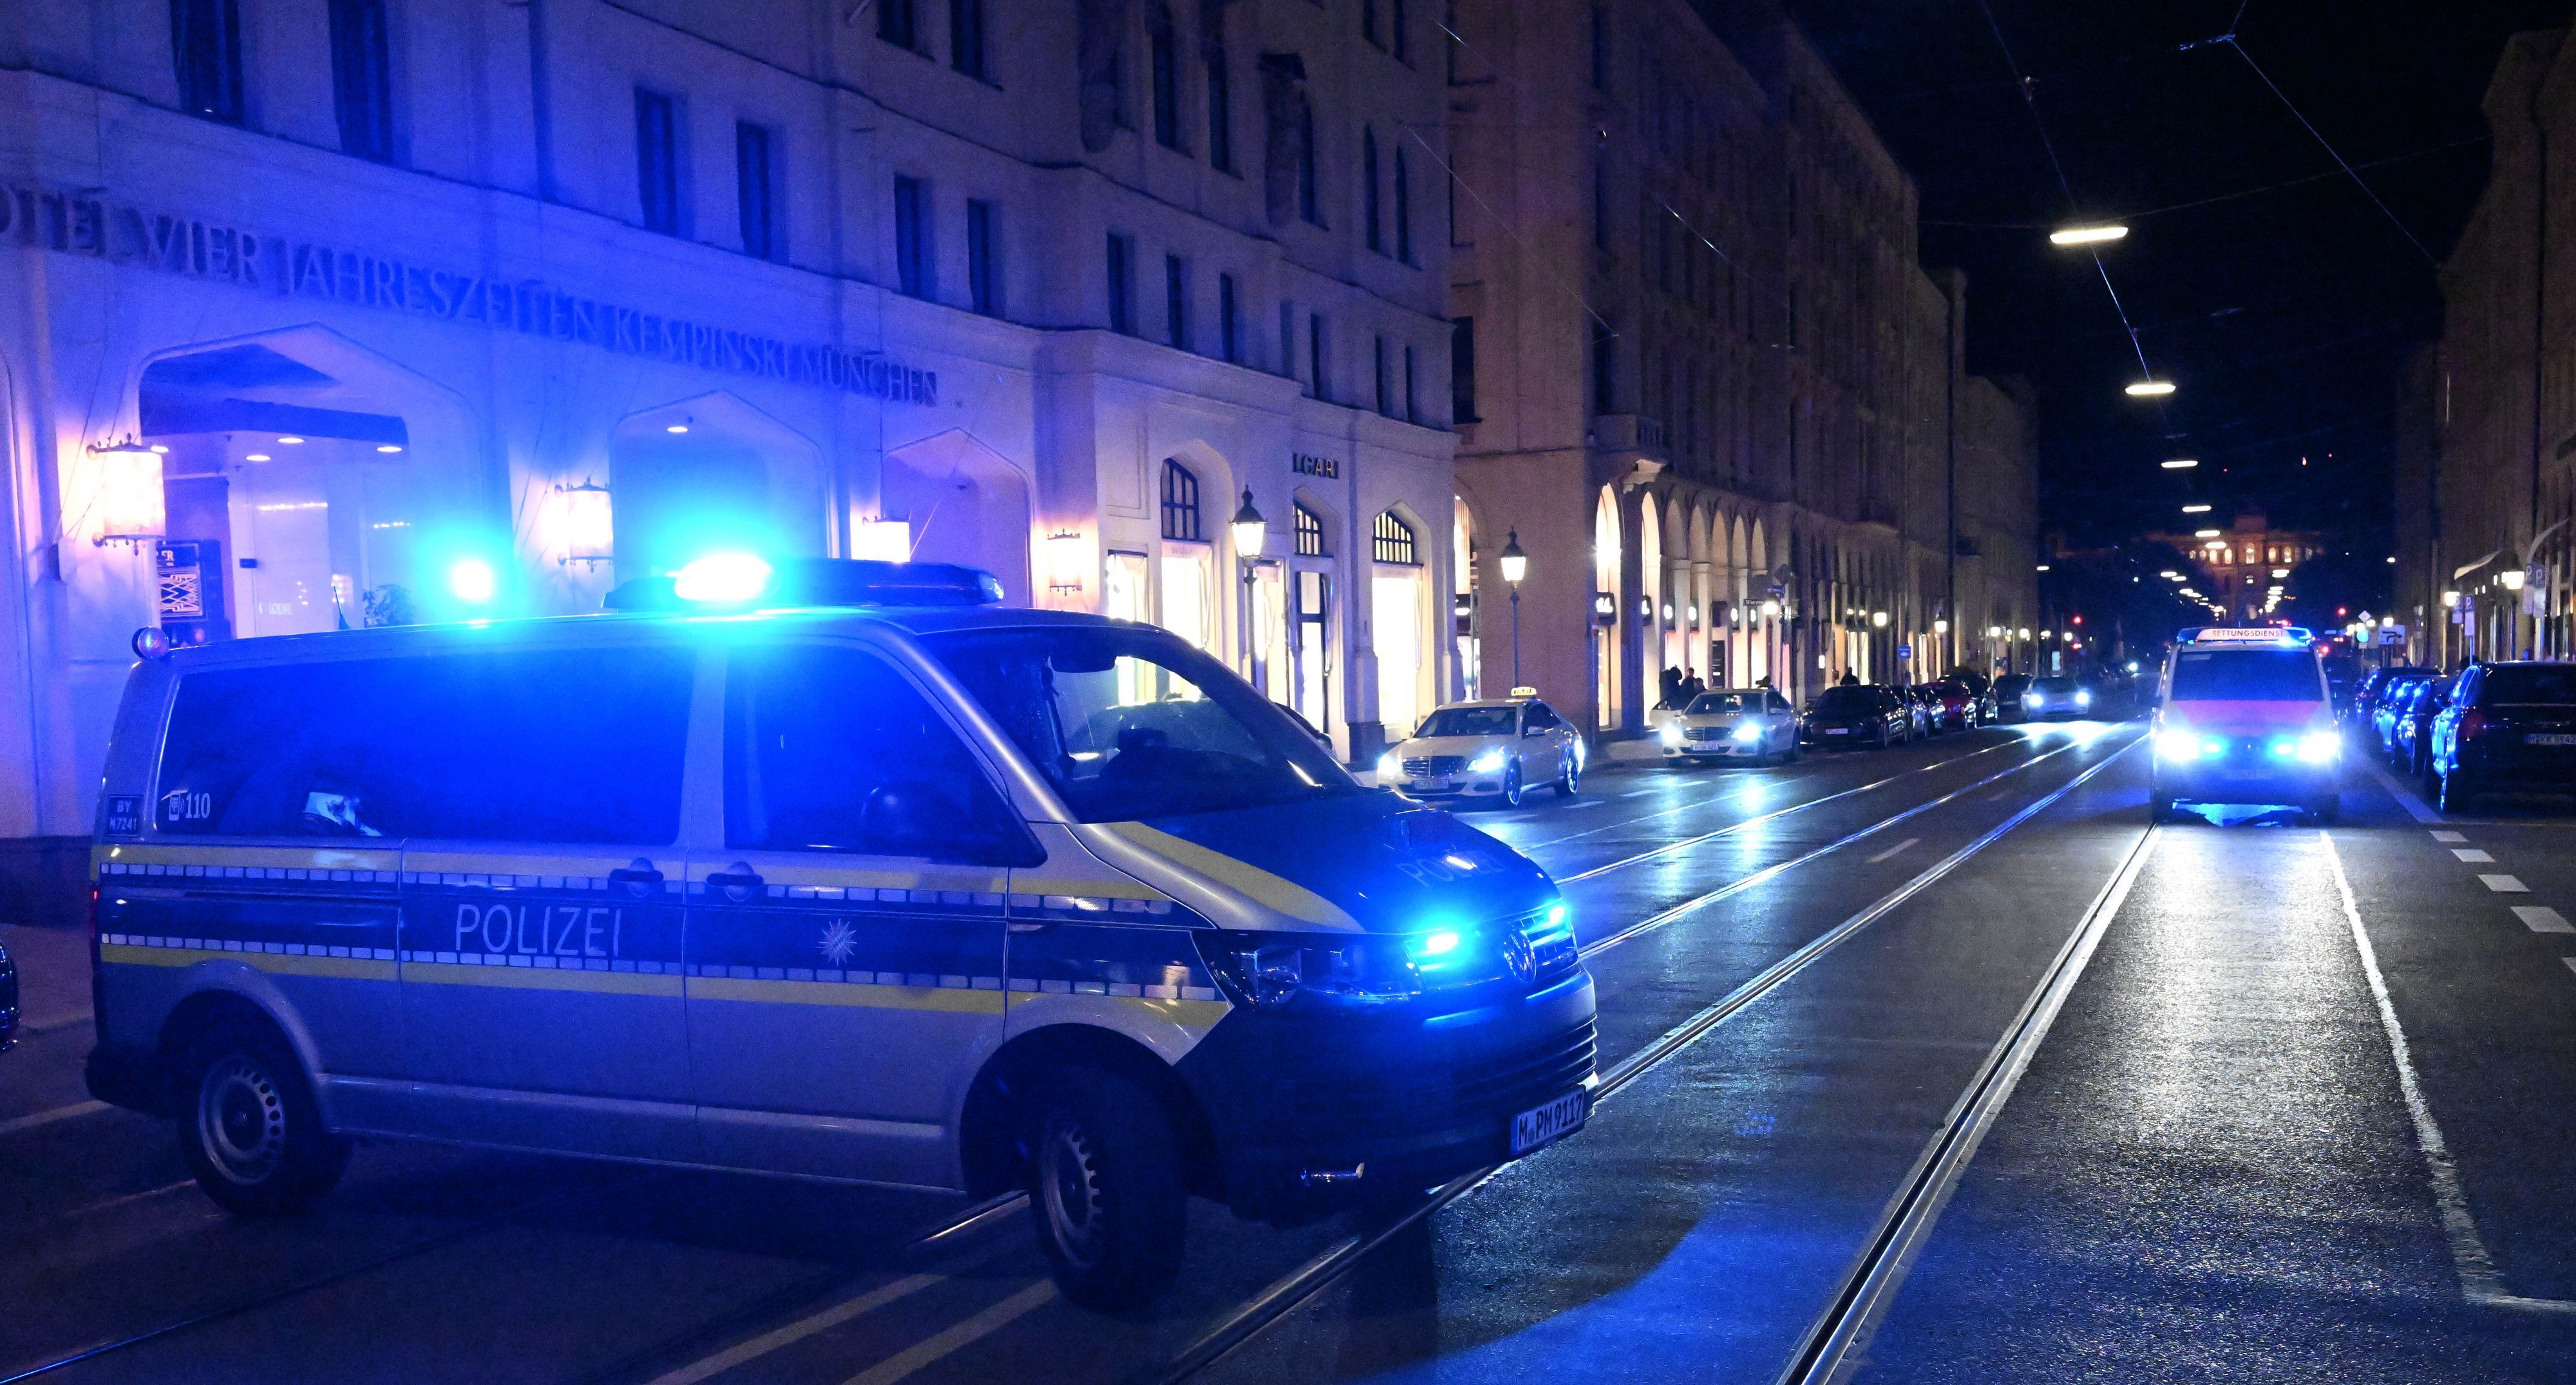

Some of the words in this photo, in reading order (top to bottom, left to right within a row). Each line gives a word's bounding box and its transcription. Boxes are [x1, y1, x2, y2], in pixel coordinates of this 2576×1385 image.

[140, 210, 256, 283] VIER
[282, 240, 598, 346] JAHRESZEITEN
[616, 308, 789, 379] KEMPINSKI
[117, 800, 132, 813] BY
[185, 793, 211, 818] 110
[456, 903, 621, 957] POLIZEI
